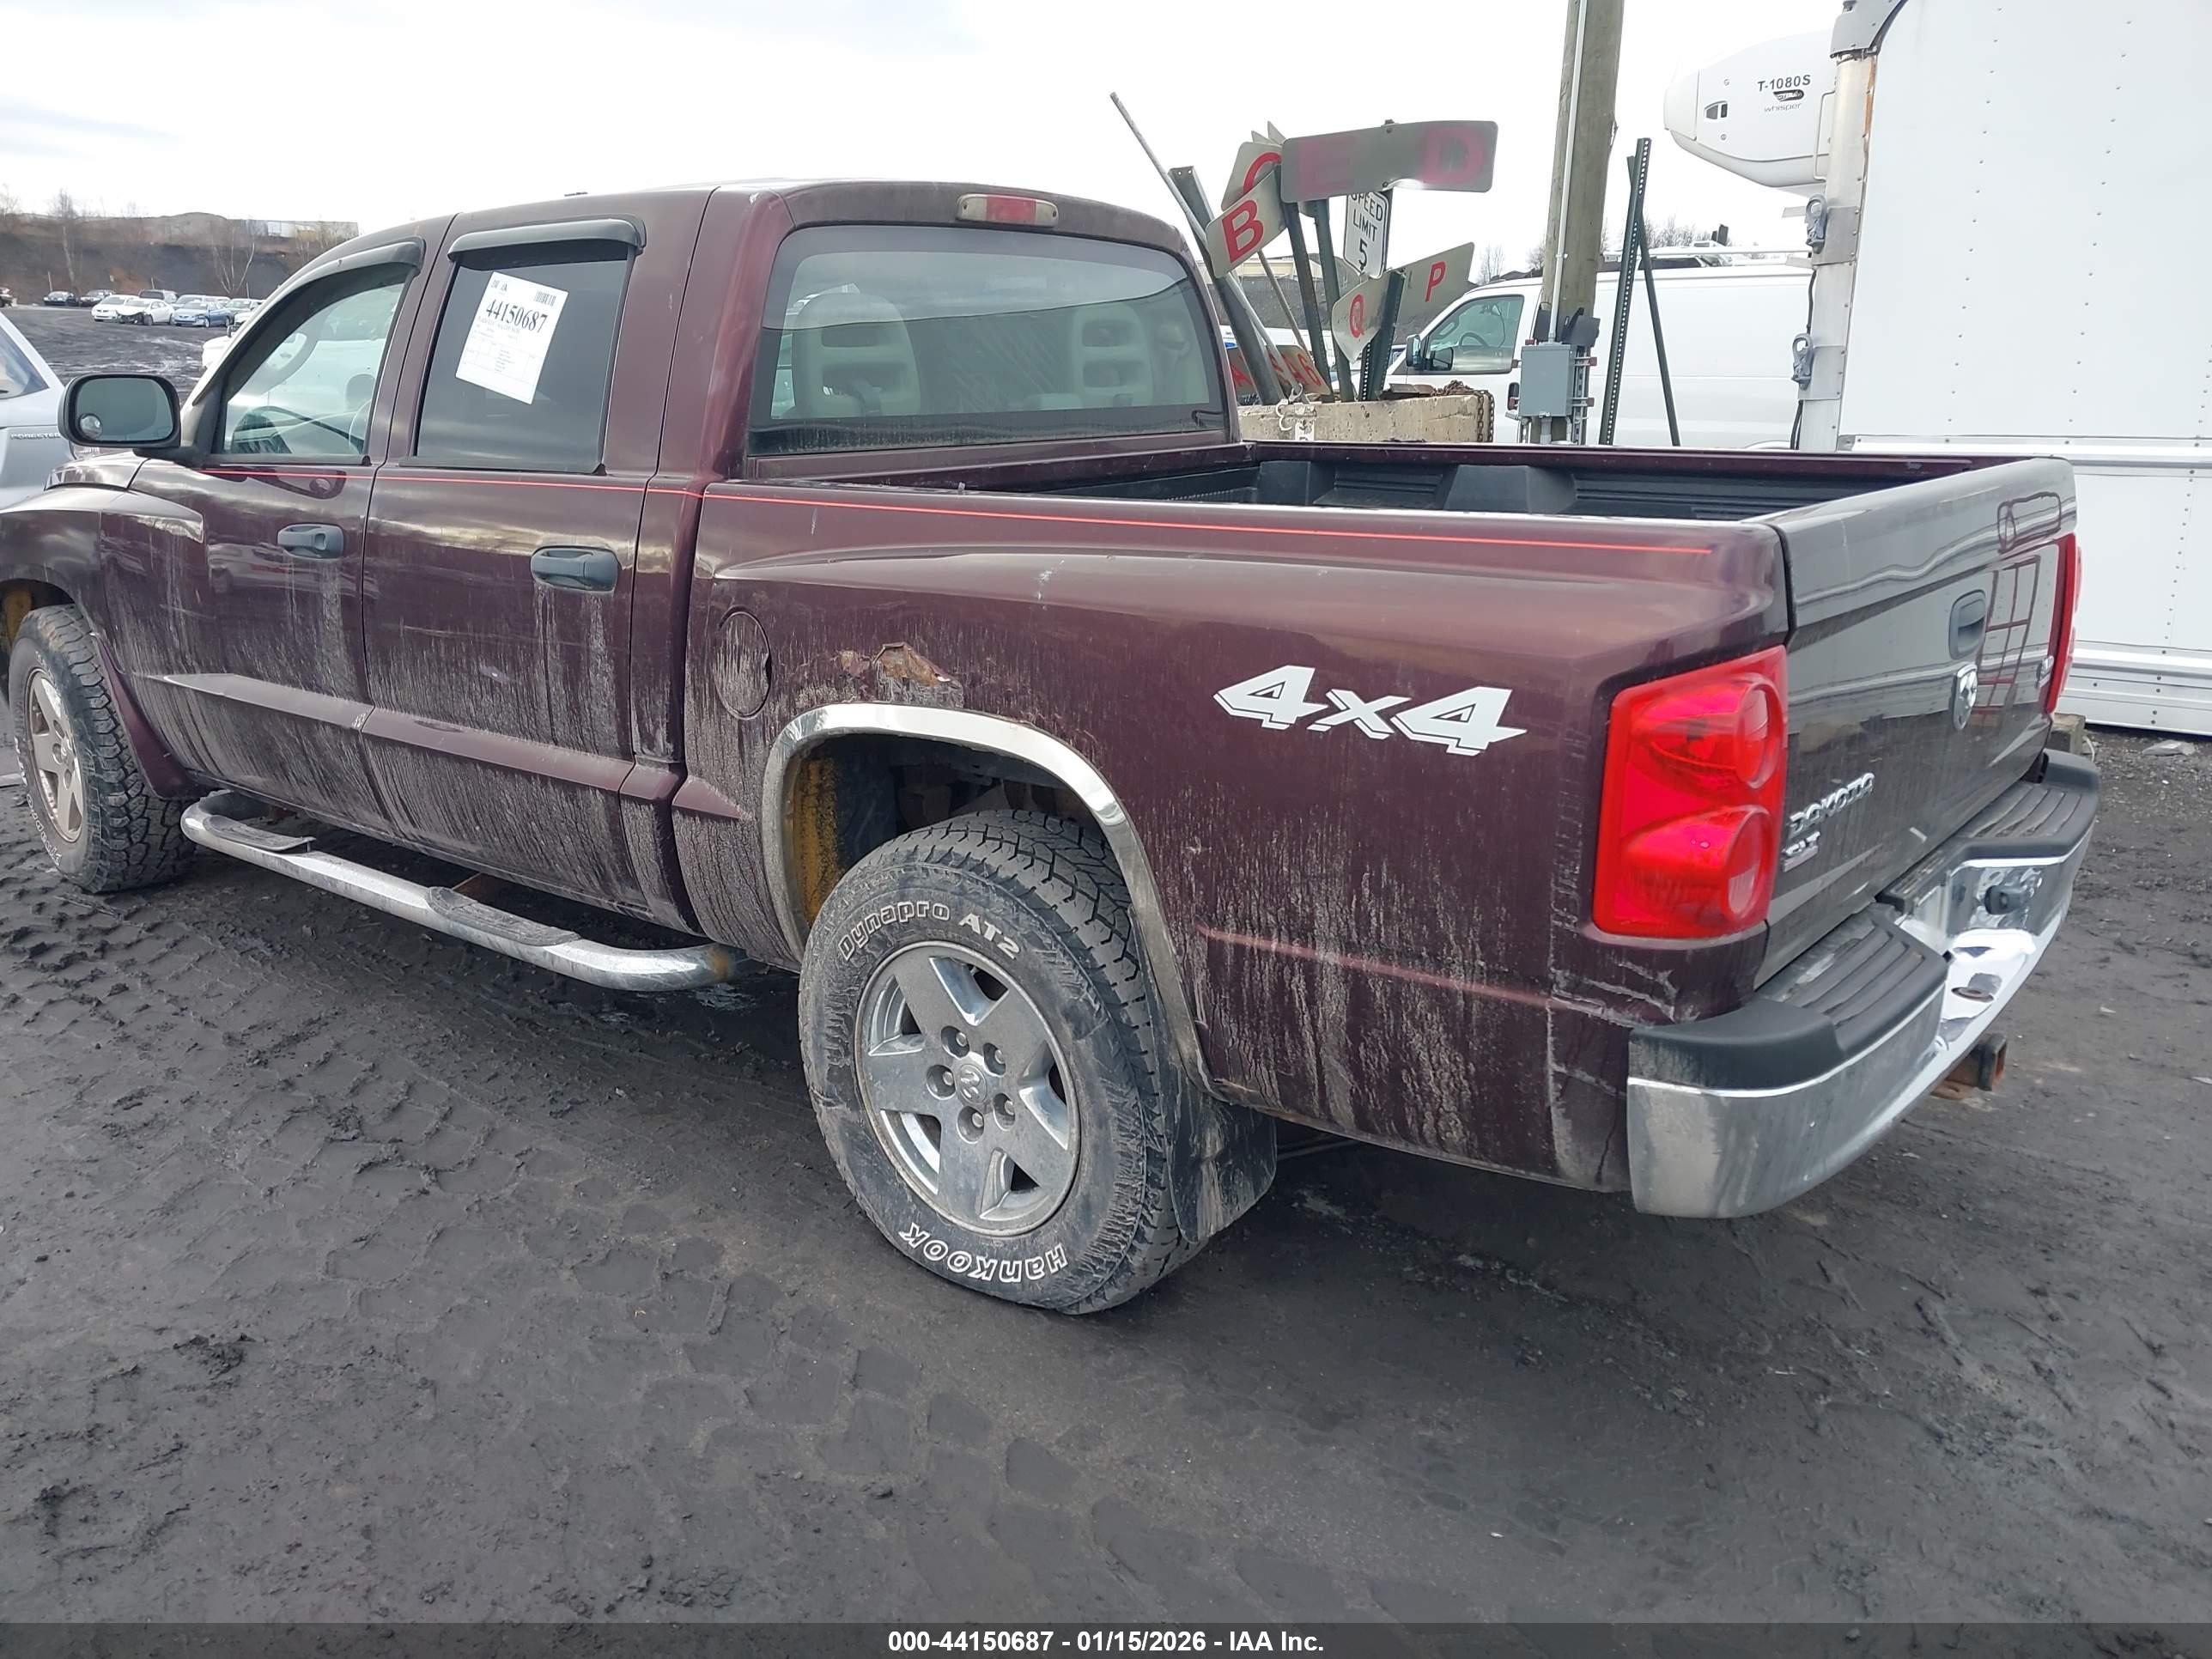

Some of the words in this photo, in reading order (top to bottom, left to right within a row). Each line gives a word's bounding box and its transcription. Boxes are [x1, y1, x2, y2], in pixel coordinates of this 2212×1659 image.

[1757, 74, 1811, 92] T-1080S
[1222, 199, 1264, 263] B
[1352, 208, 1377, 242] LIMIT
[1358, 238, 1368, 267] 5
[1425, 260, 1446, 302] P
[486, 299, 548, 333] 44150687
[1349, 293, 1365, 338] Q
[837, 902, 951, 962] Dynapro
[957, 912, 1021, 960] AT2
